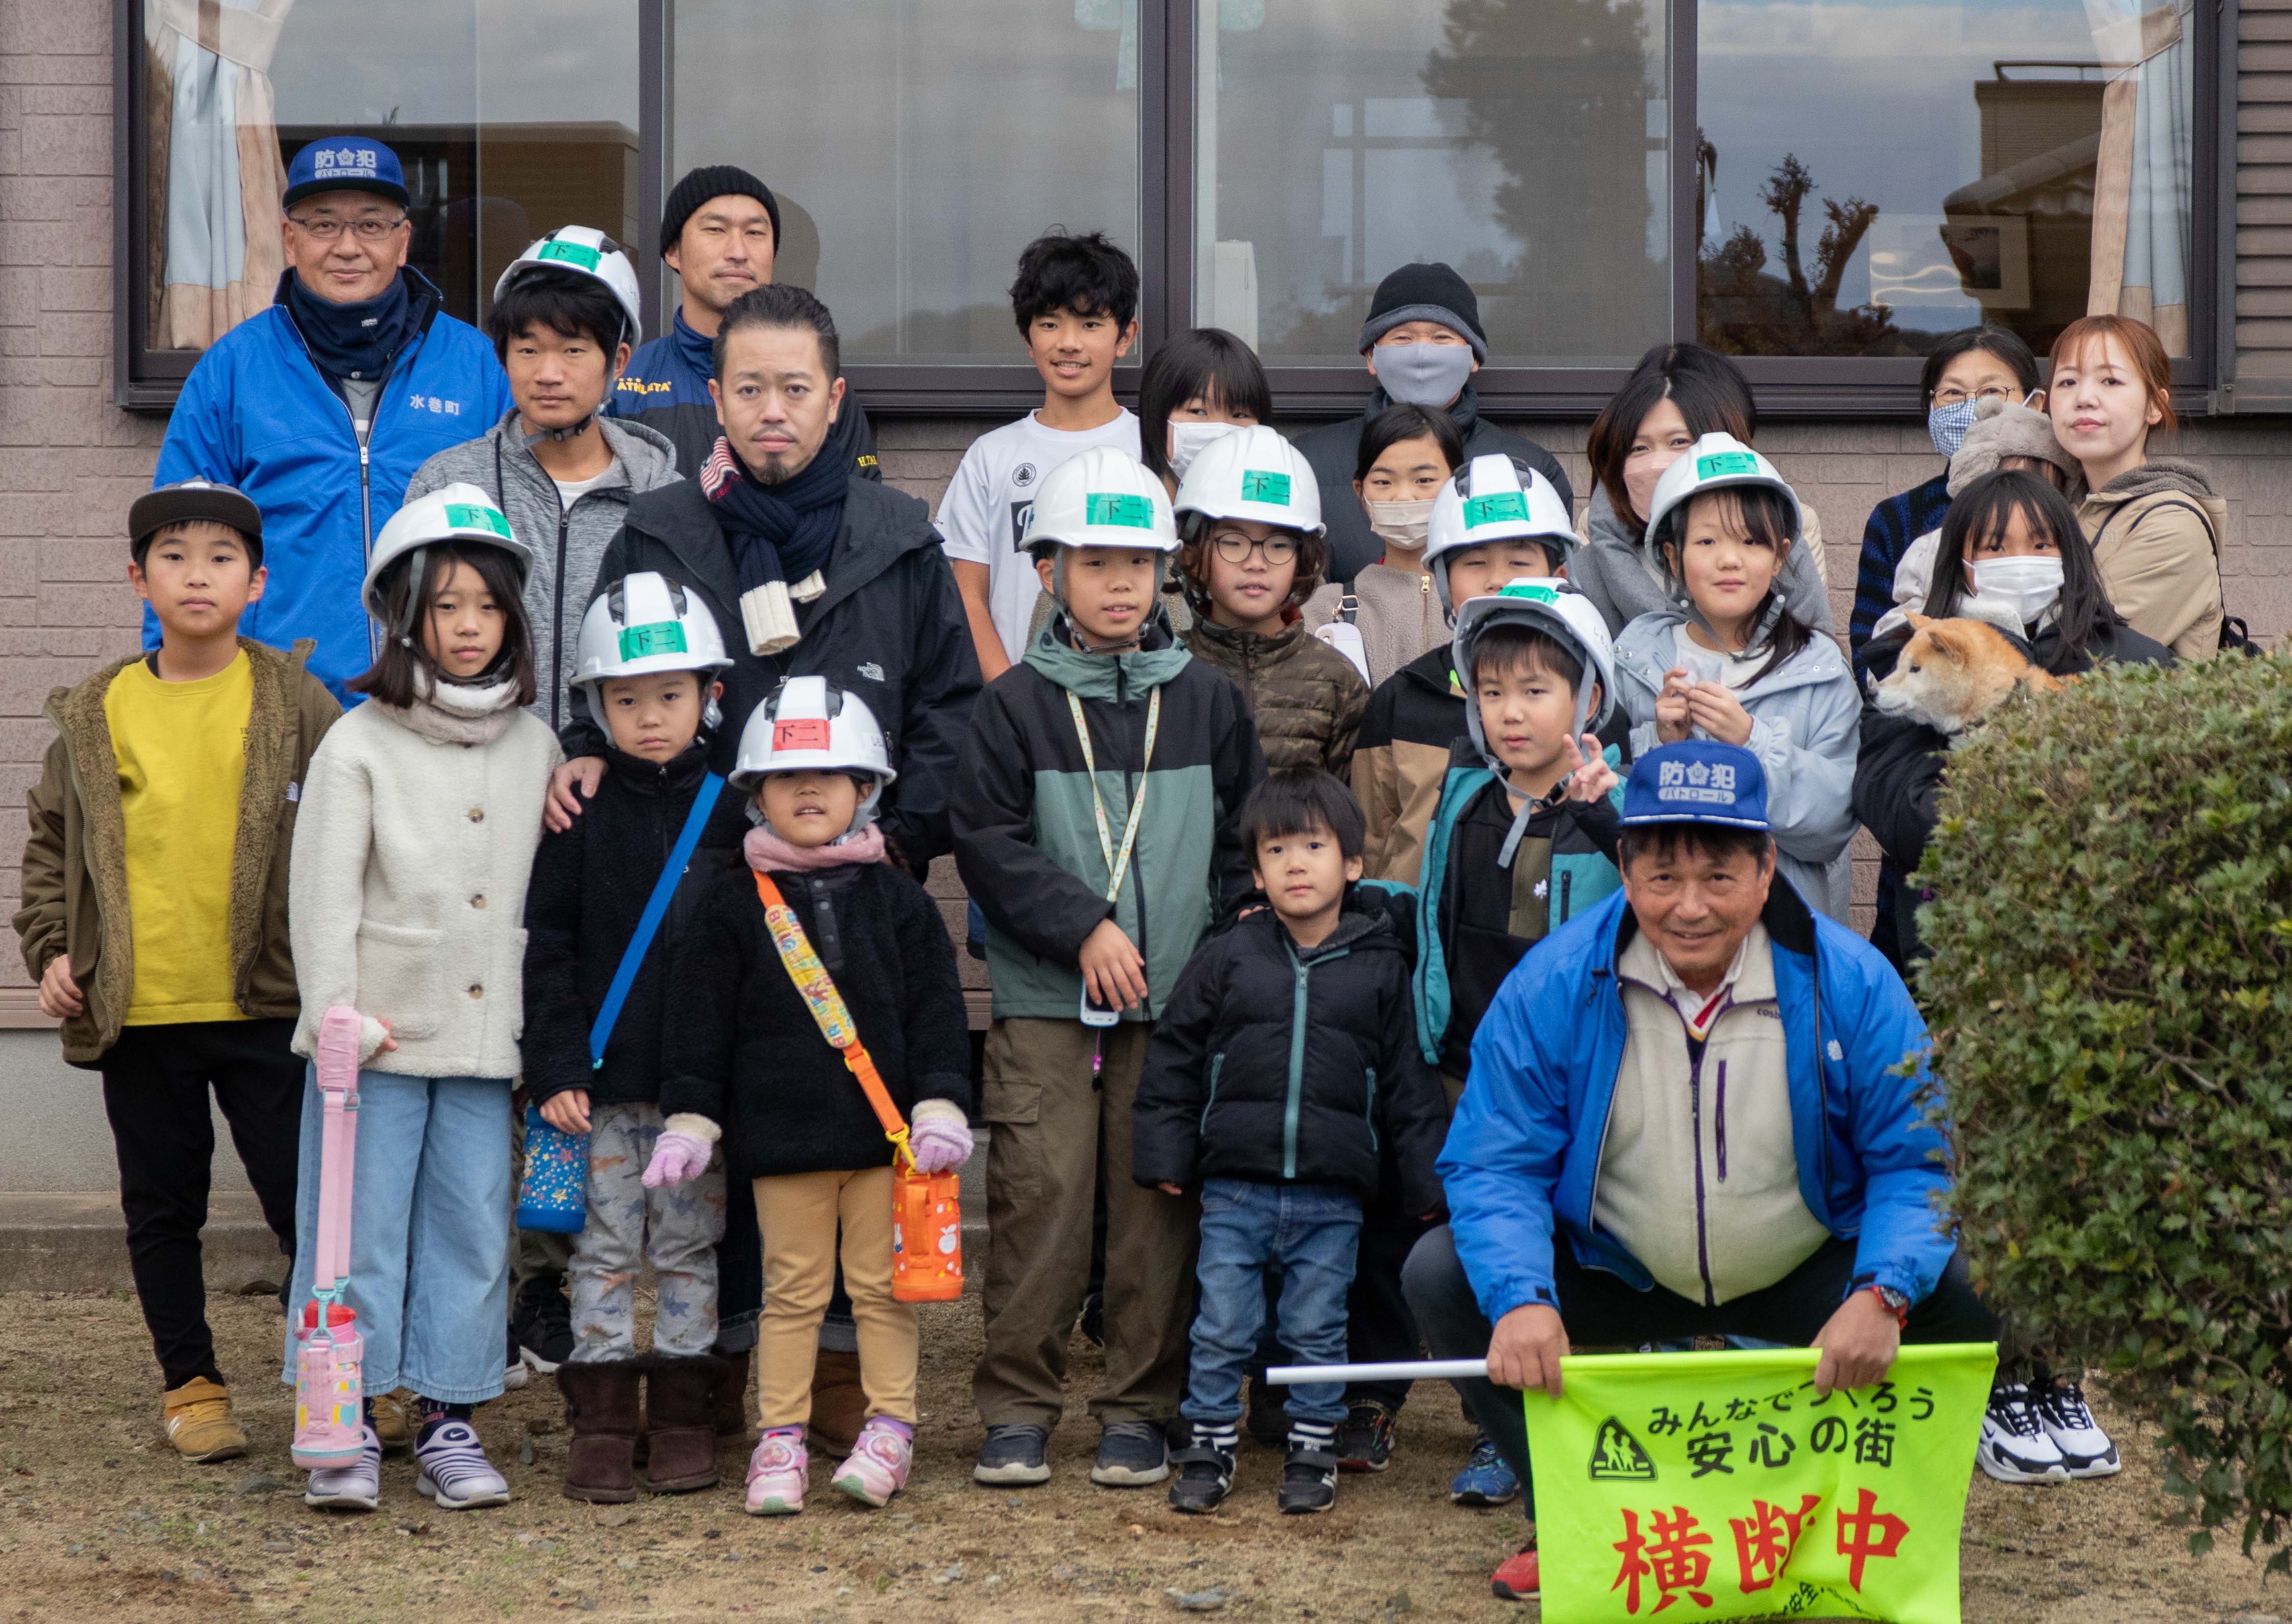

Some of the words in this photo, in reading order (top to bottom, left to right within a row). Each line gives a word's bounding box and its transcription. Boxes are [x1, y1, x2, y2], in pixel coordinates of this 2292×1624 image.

[617, 381, 671, 395] ATHLETA
[410, 394, 459, 416] 水巻町
[1702, 456, 1747, 473] 下二
[1250, 476, 1290, 498] 下二
[1101, 499, 1143, 520] 下二
[1474, 498, 1519, 519] 下二
[630, 628, 676, 650] 下二
[775, 723, 818, 744] 下二
[1660, 760, 1736, 790] 防犯
[1664, 788, 1728, 802] パトロール
[1687, 1416, 1896, 1478] 安心の街
[1610, 1487, 1910, 1616] 横断中
